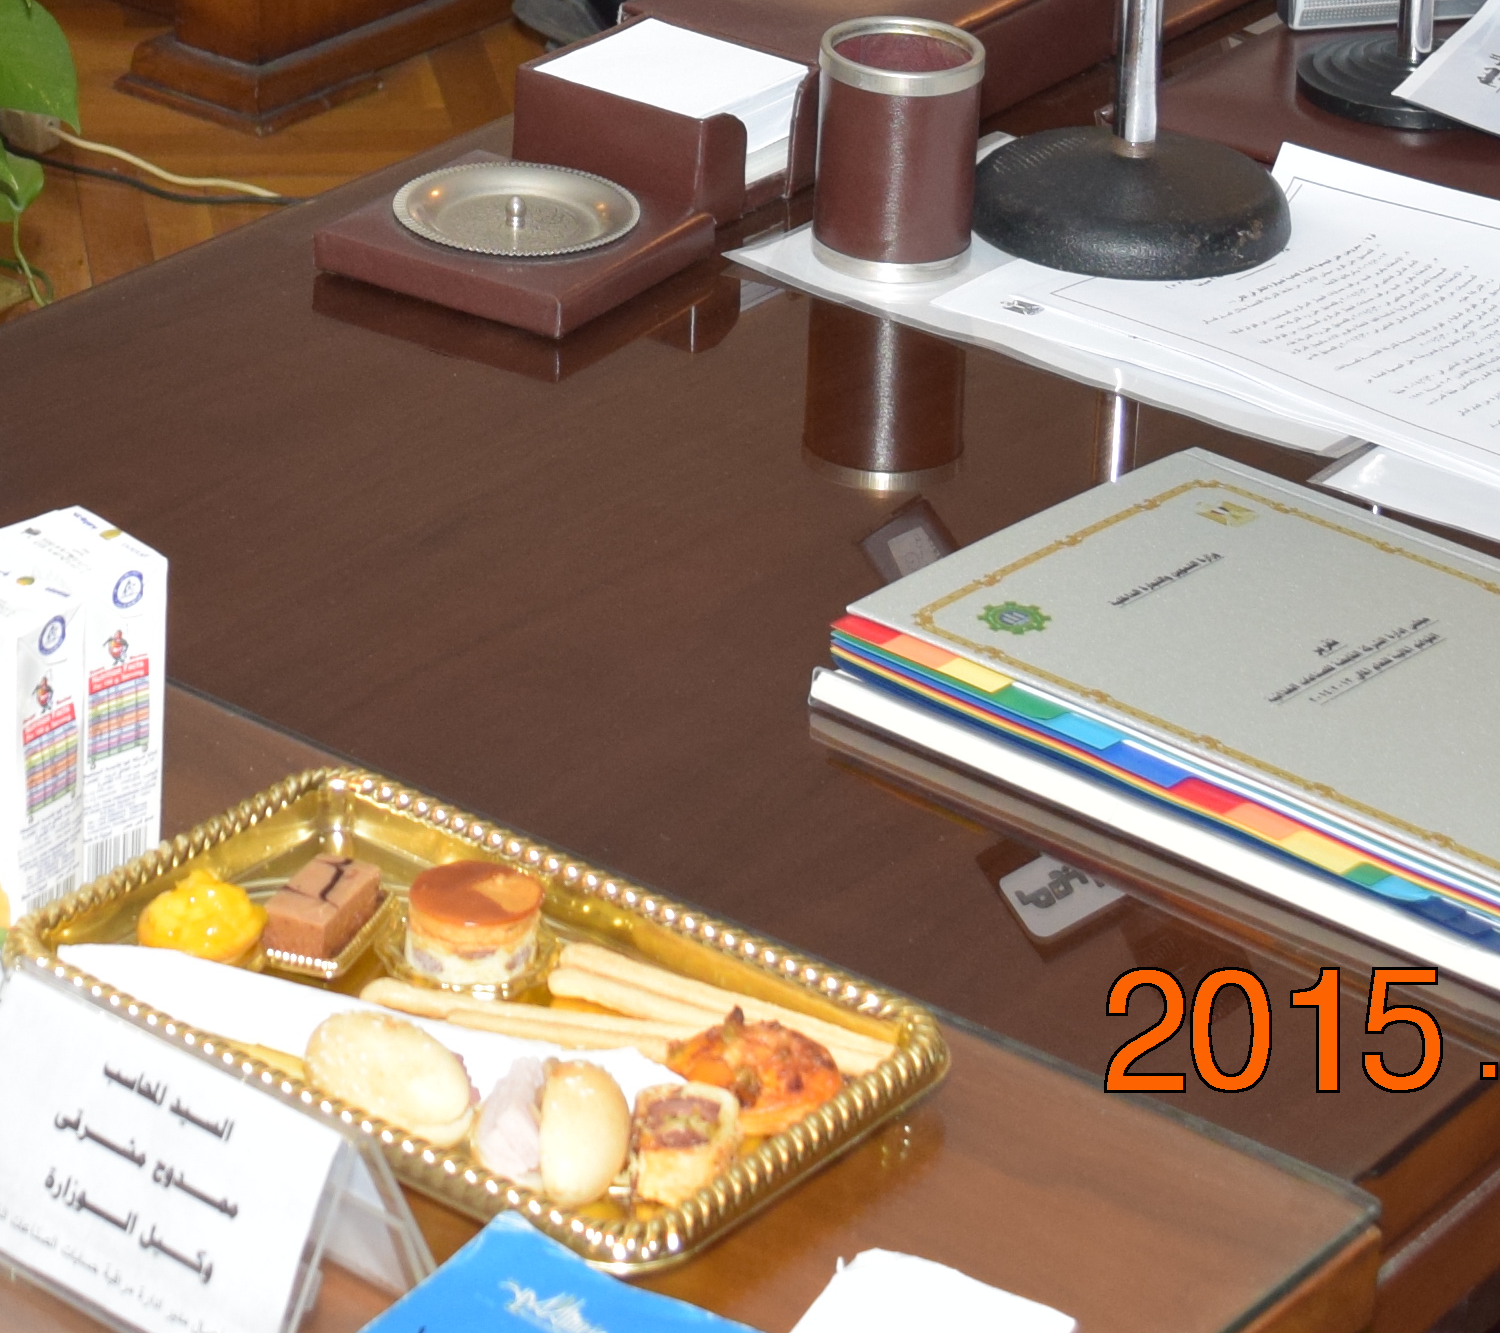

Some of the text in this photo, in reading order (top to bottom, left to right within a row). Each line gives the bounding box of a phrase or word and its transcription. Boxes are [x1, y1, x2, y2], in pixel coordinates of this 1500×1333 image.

[102, 1058, 236, 1144] السيد المحاسب
[42, 1171, 215, 1286] وكيل الوزارة
[150, 1159, 240, 1221] ممدوح
